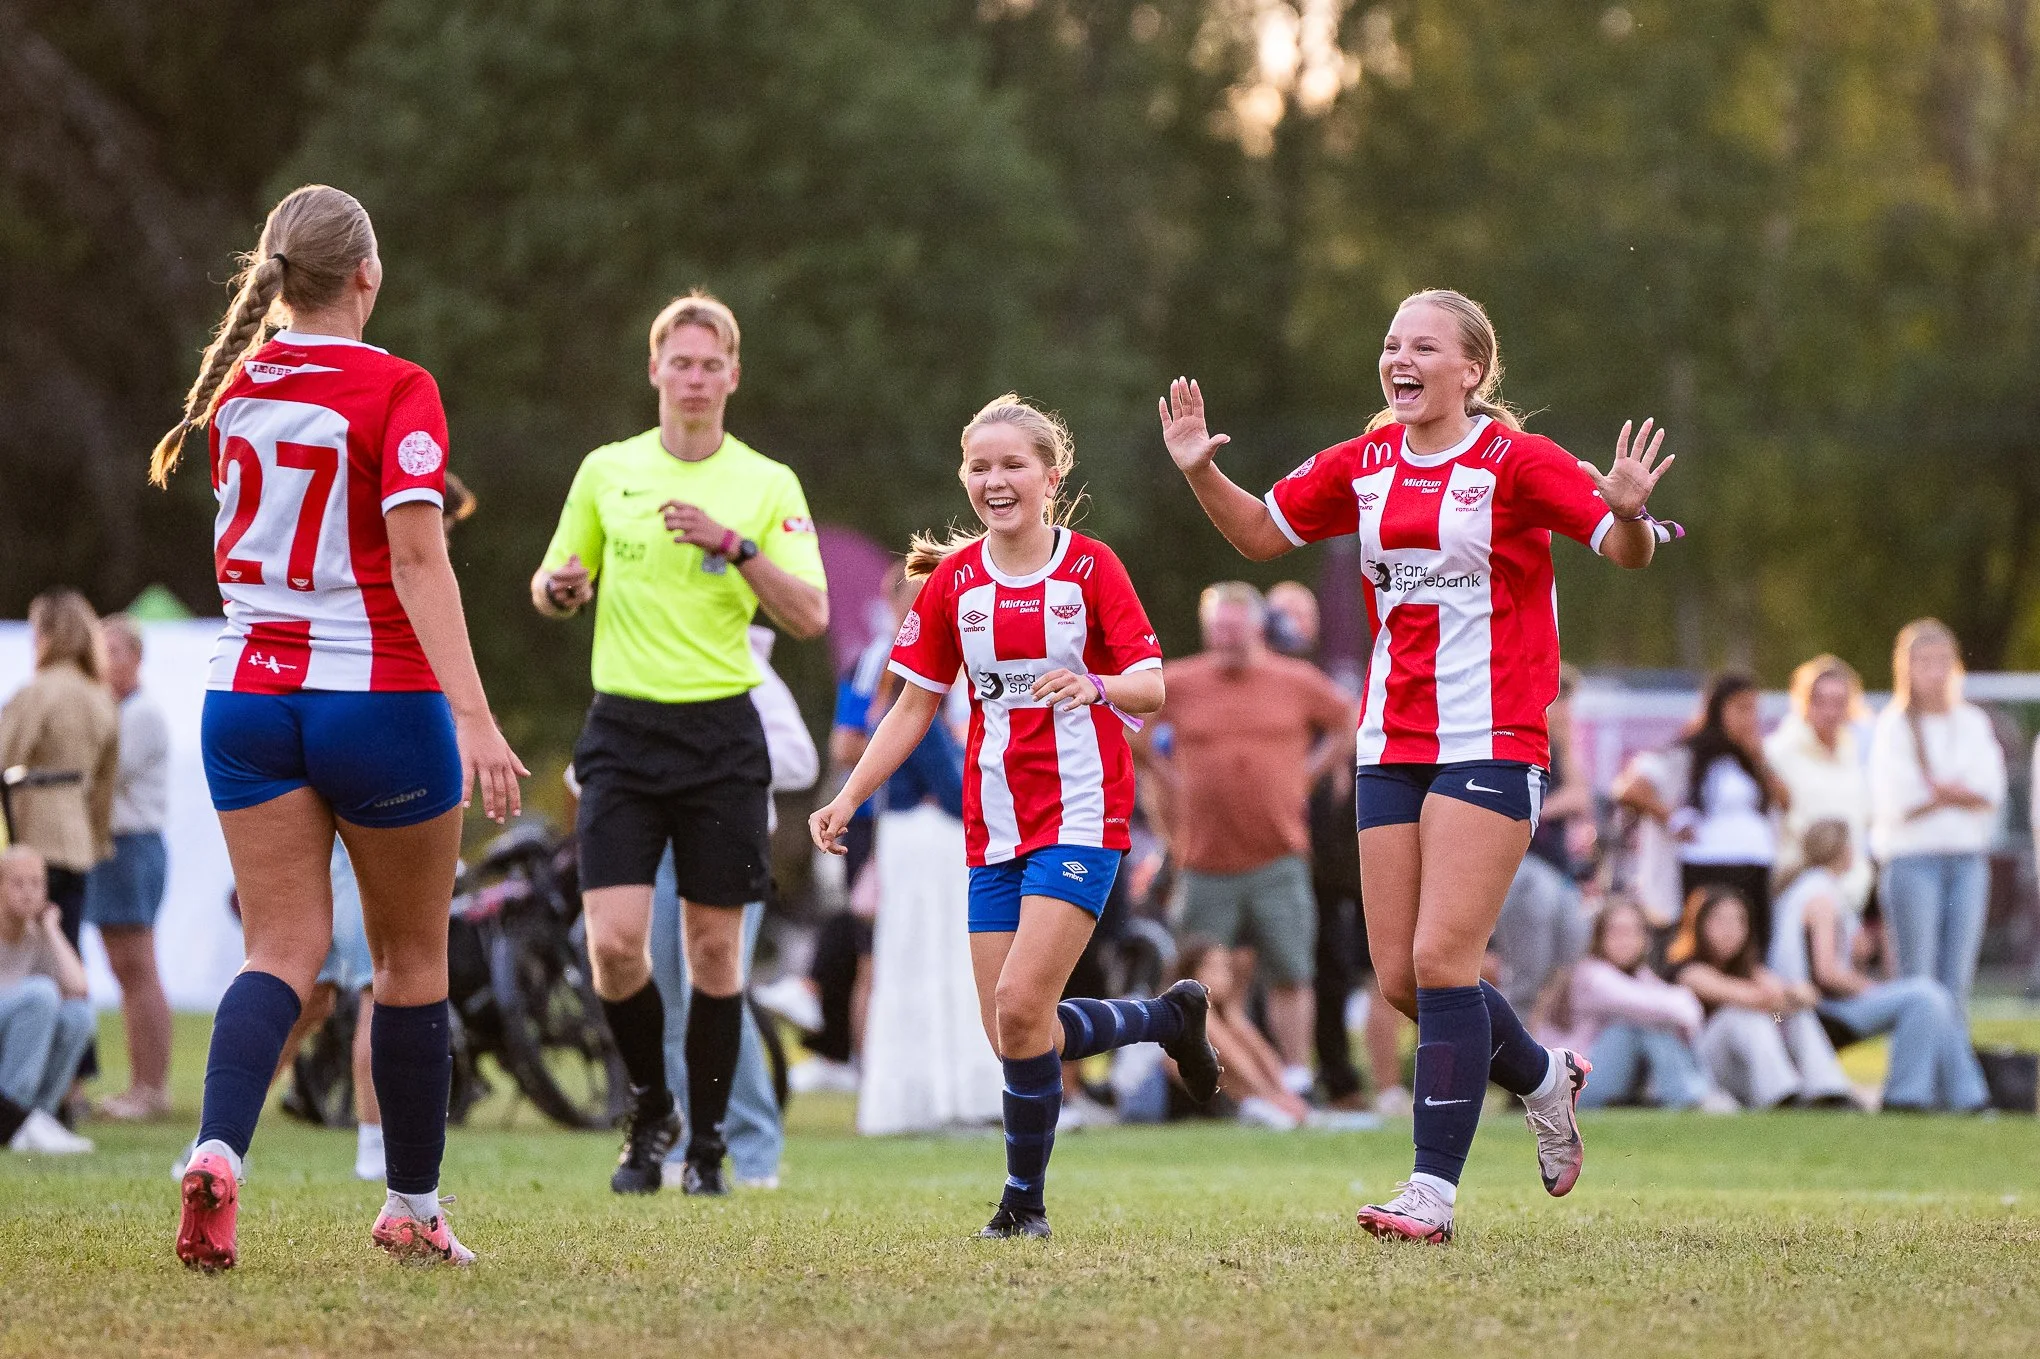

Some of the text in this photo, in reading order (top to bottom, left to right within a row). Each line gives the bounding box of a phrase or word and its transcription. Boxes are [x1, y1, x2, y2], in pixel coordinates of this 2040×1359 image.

[1401, 478, 1442, 487] Midtun
[215, 435, 340, 592] 27
[999, 599, 1040, 609] Midtun
[963, 625, 986, 633] umbro
[1062, 870, 1084, 882] umbro
